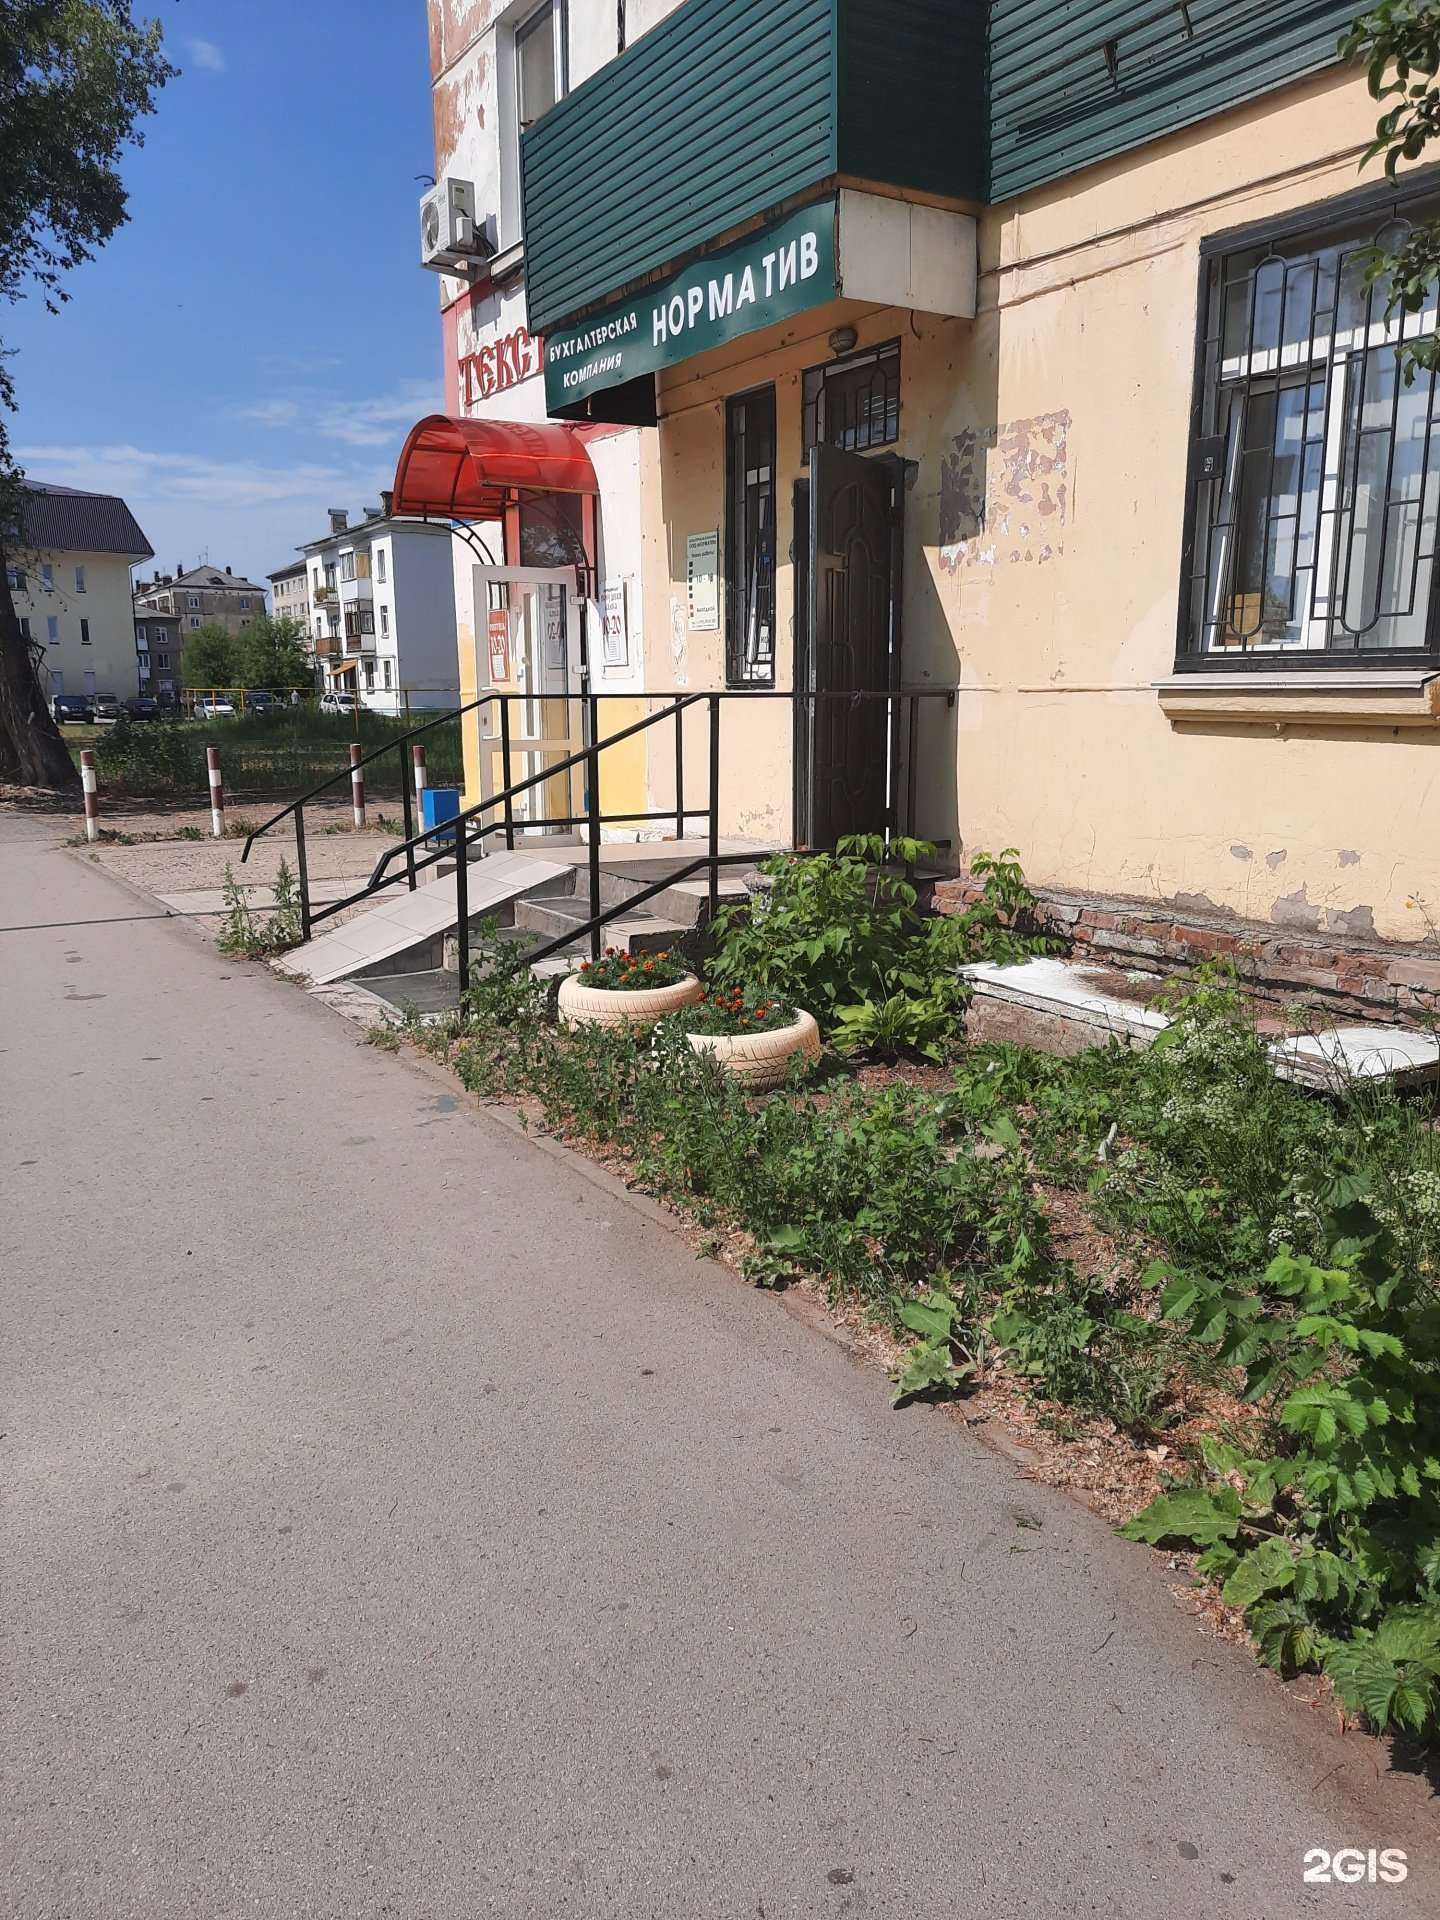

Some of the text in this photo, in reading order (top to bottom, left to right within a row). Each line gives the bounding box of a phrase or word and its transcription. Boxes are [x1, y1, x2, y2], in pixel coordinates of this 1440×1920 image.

[652, 231, 819, 347] НОРМАТИВ
[549, 311, 638, 363] БУХГАЛТЕРСКАЯ
[562, 352, 623, 389] КОМПАНИЯ
